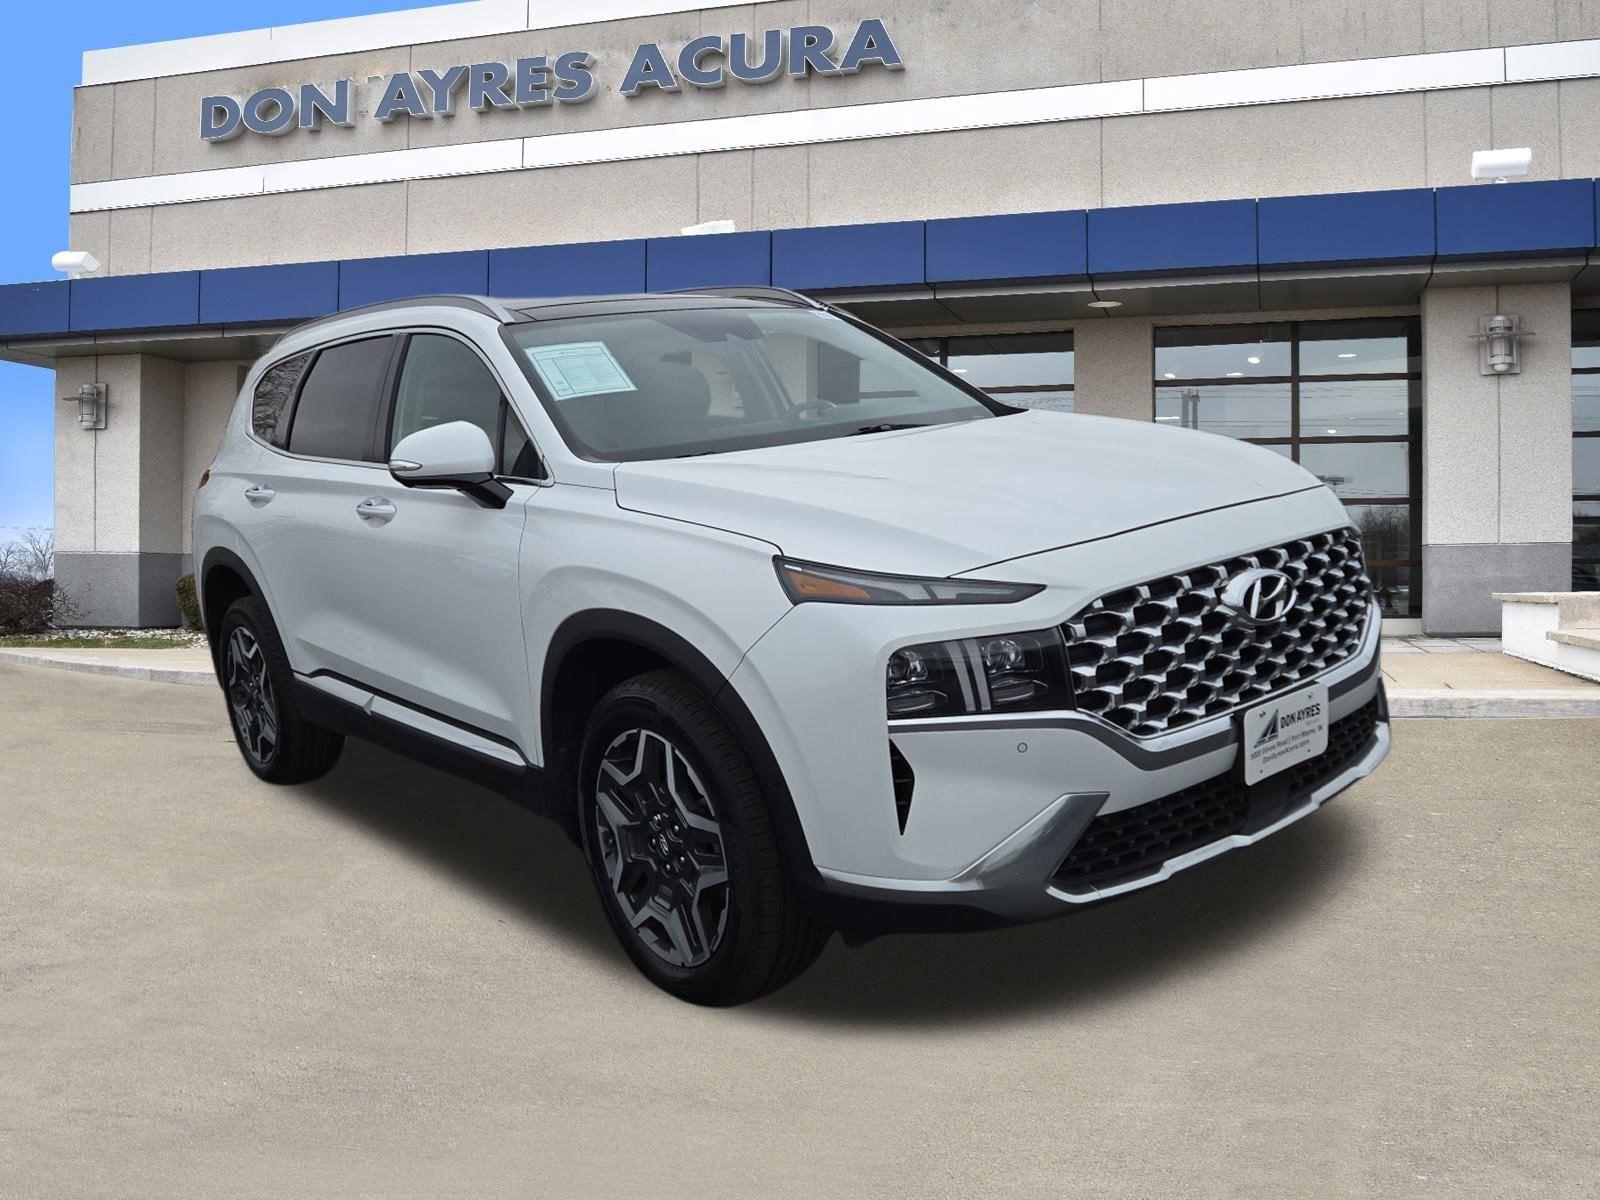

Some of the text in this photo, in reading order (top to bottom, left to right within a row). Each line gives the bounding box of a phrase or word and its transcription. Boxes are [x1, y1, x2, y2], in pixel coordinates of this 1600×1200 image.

[200, 17, 904, 141] DON AYRES ACURA
[1280, 712, 1297, 729] DON
[1297, 703, 1321, 722] AYRES
